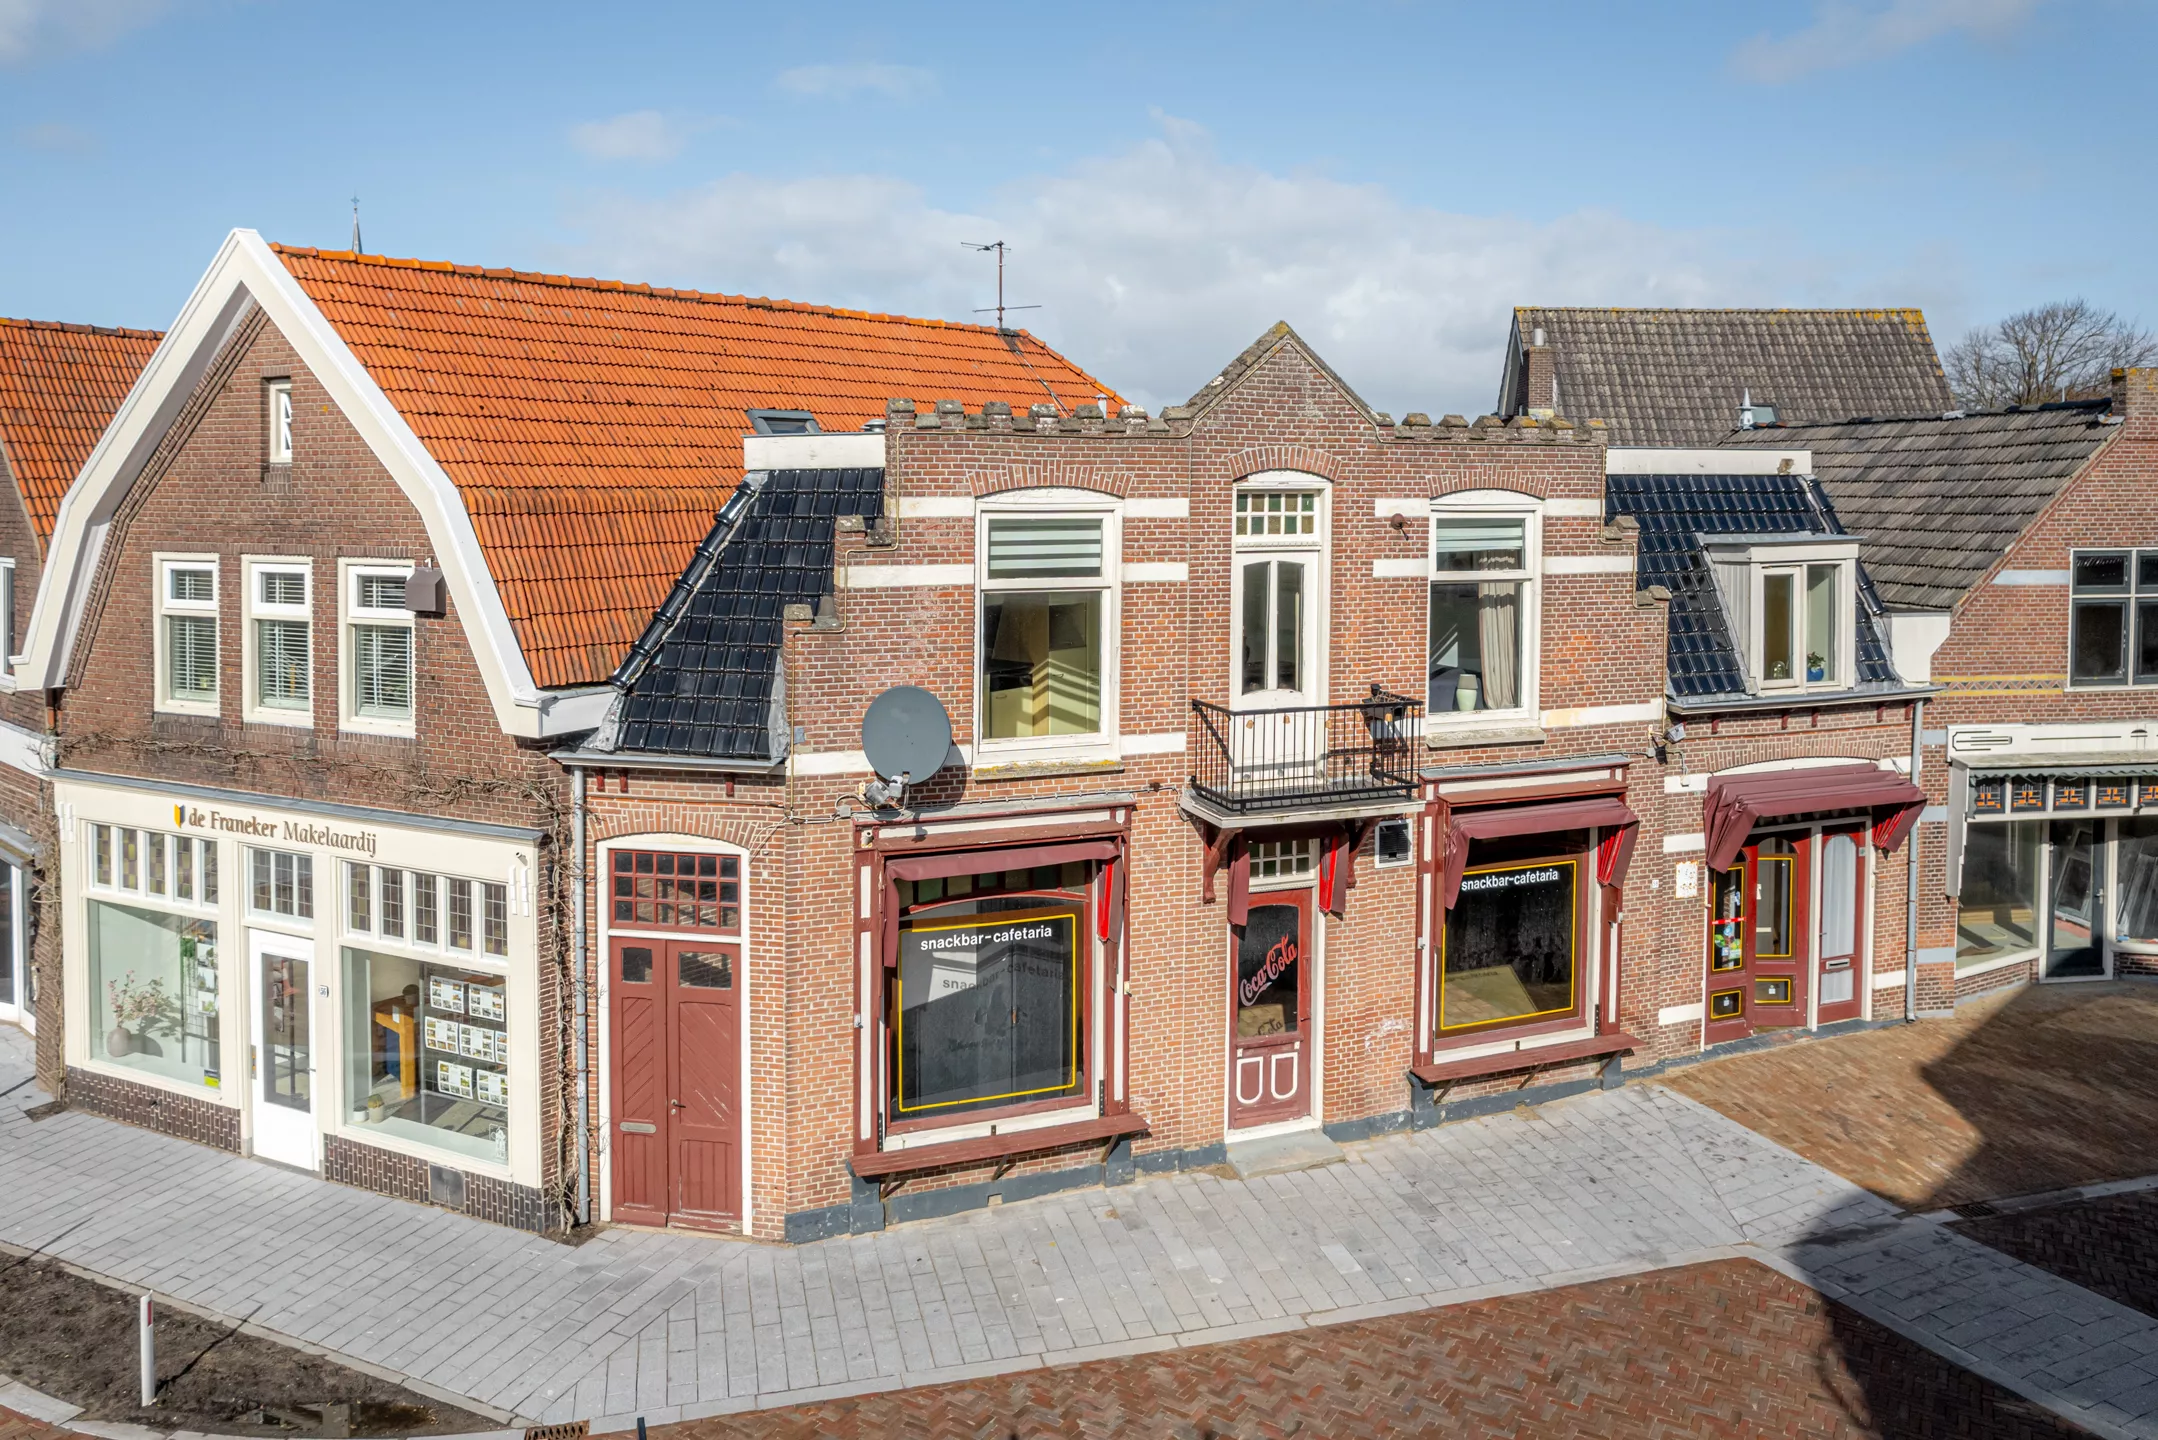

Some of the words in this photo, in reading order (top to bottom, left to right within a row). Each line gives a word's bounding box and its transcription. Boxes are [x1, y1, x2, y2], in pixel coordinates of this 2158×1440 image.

[188, 808, 205, 827] de
[210, 810, 278, 838] Franeker
[283, 820, 377, 858] Makelaardij
[1461, 868, 1558, 891] snackbar-cafetaria
[920, 925, 1052, 951] snackbar-cafetaria
[1239, 933, 1298, 1007] Coca-Cola
